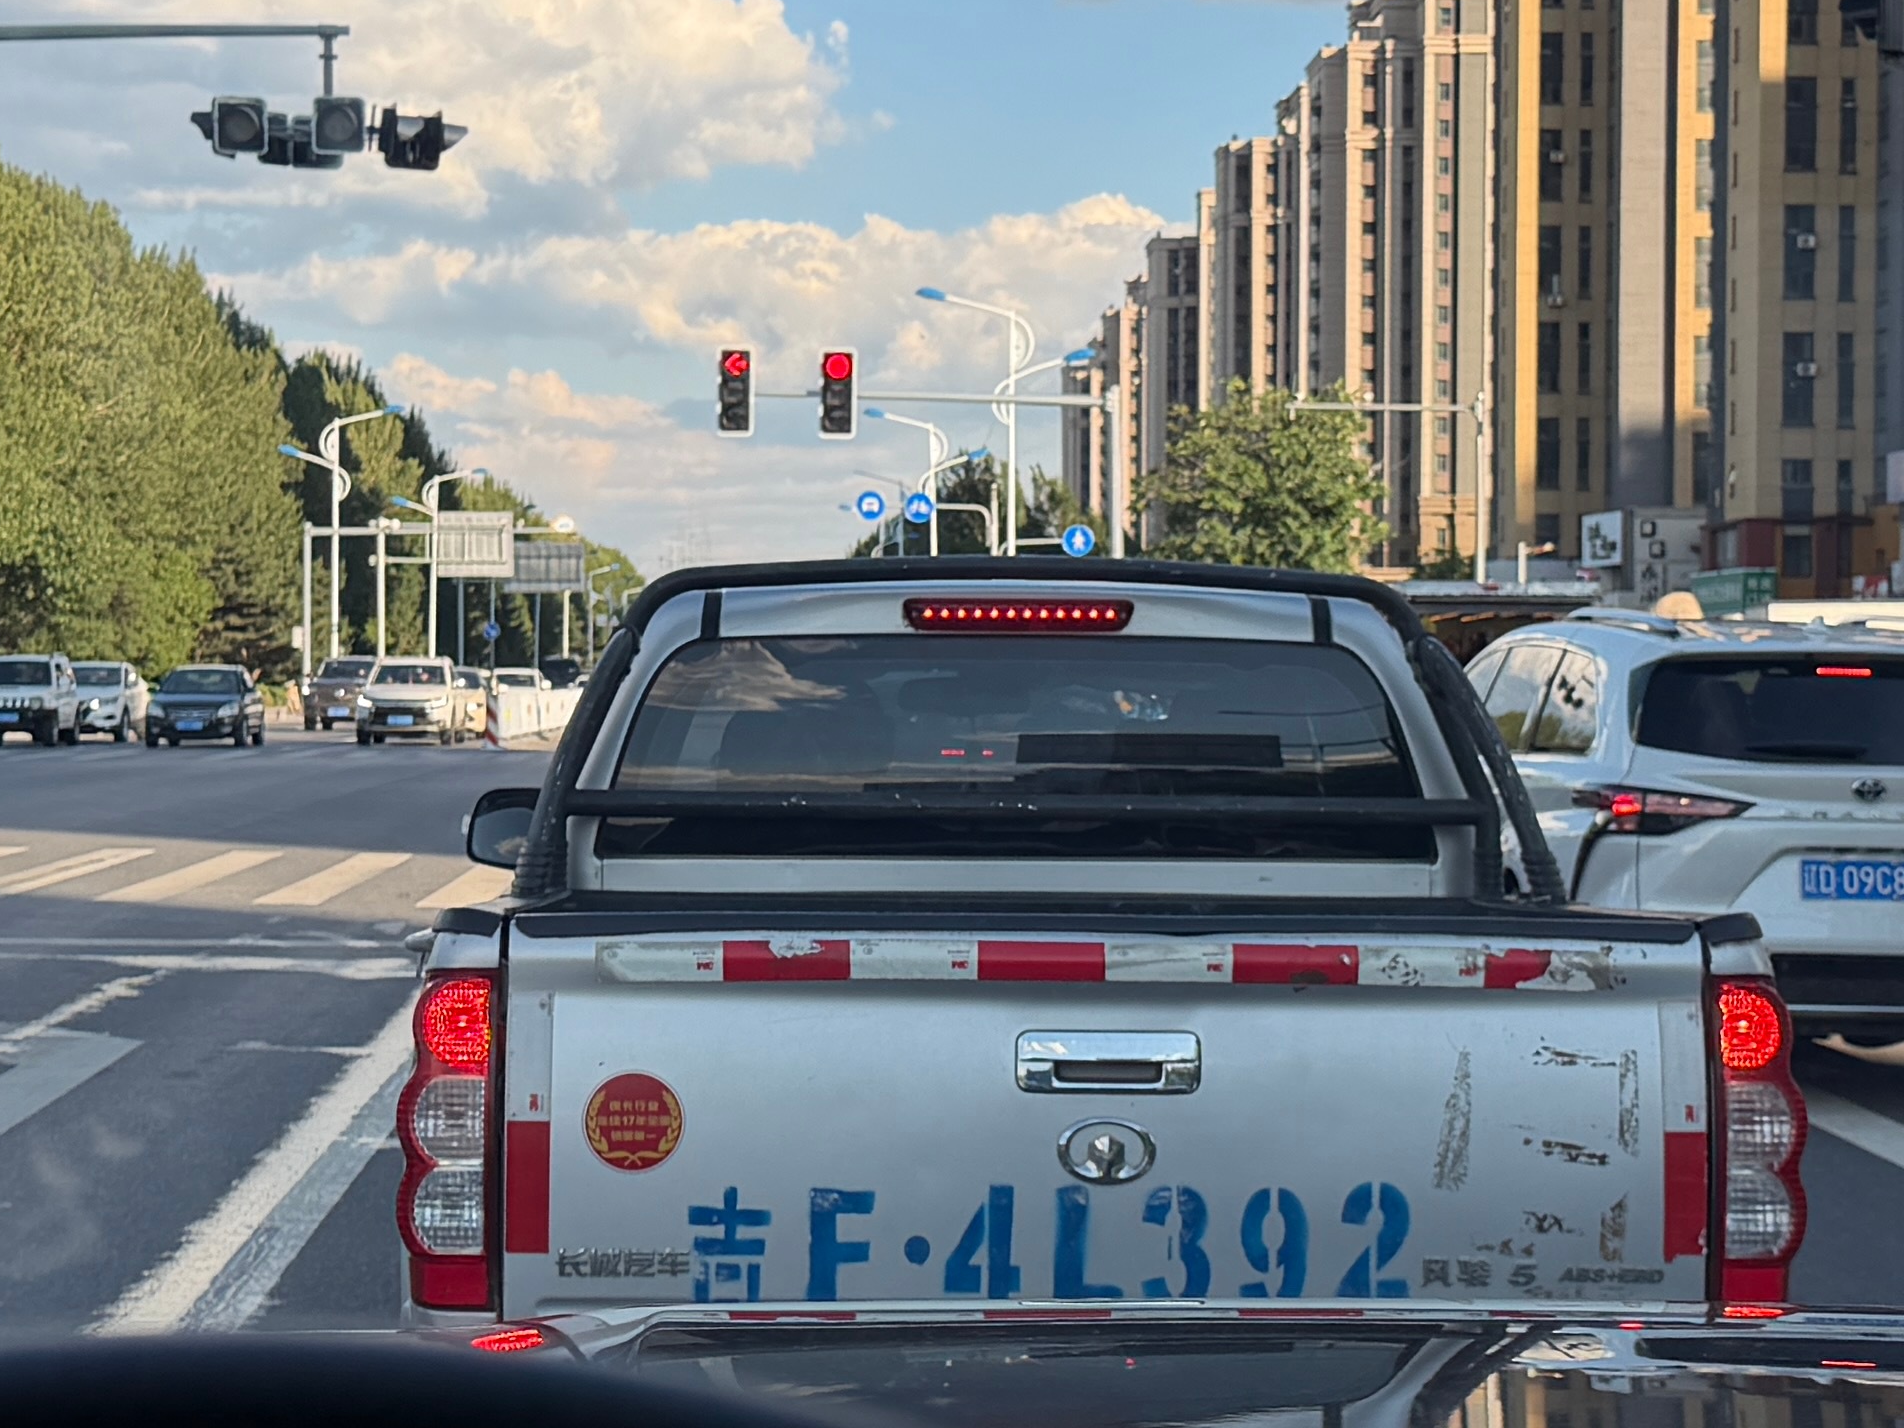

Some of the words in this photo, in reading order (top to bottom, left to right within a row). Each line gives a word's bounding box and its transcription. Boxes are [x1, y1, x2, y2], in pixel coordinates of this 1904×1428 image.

[555, 1247, 691, 1277] 长城汽车
[1422, 1257, 1492, 1287] 风骏
[1507, 1260, 1537, 1287] 5
[1558, 1266, 1665, 1284] ABS+EBD
